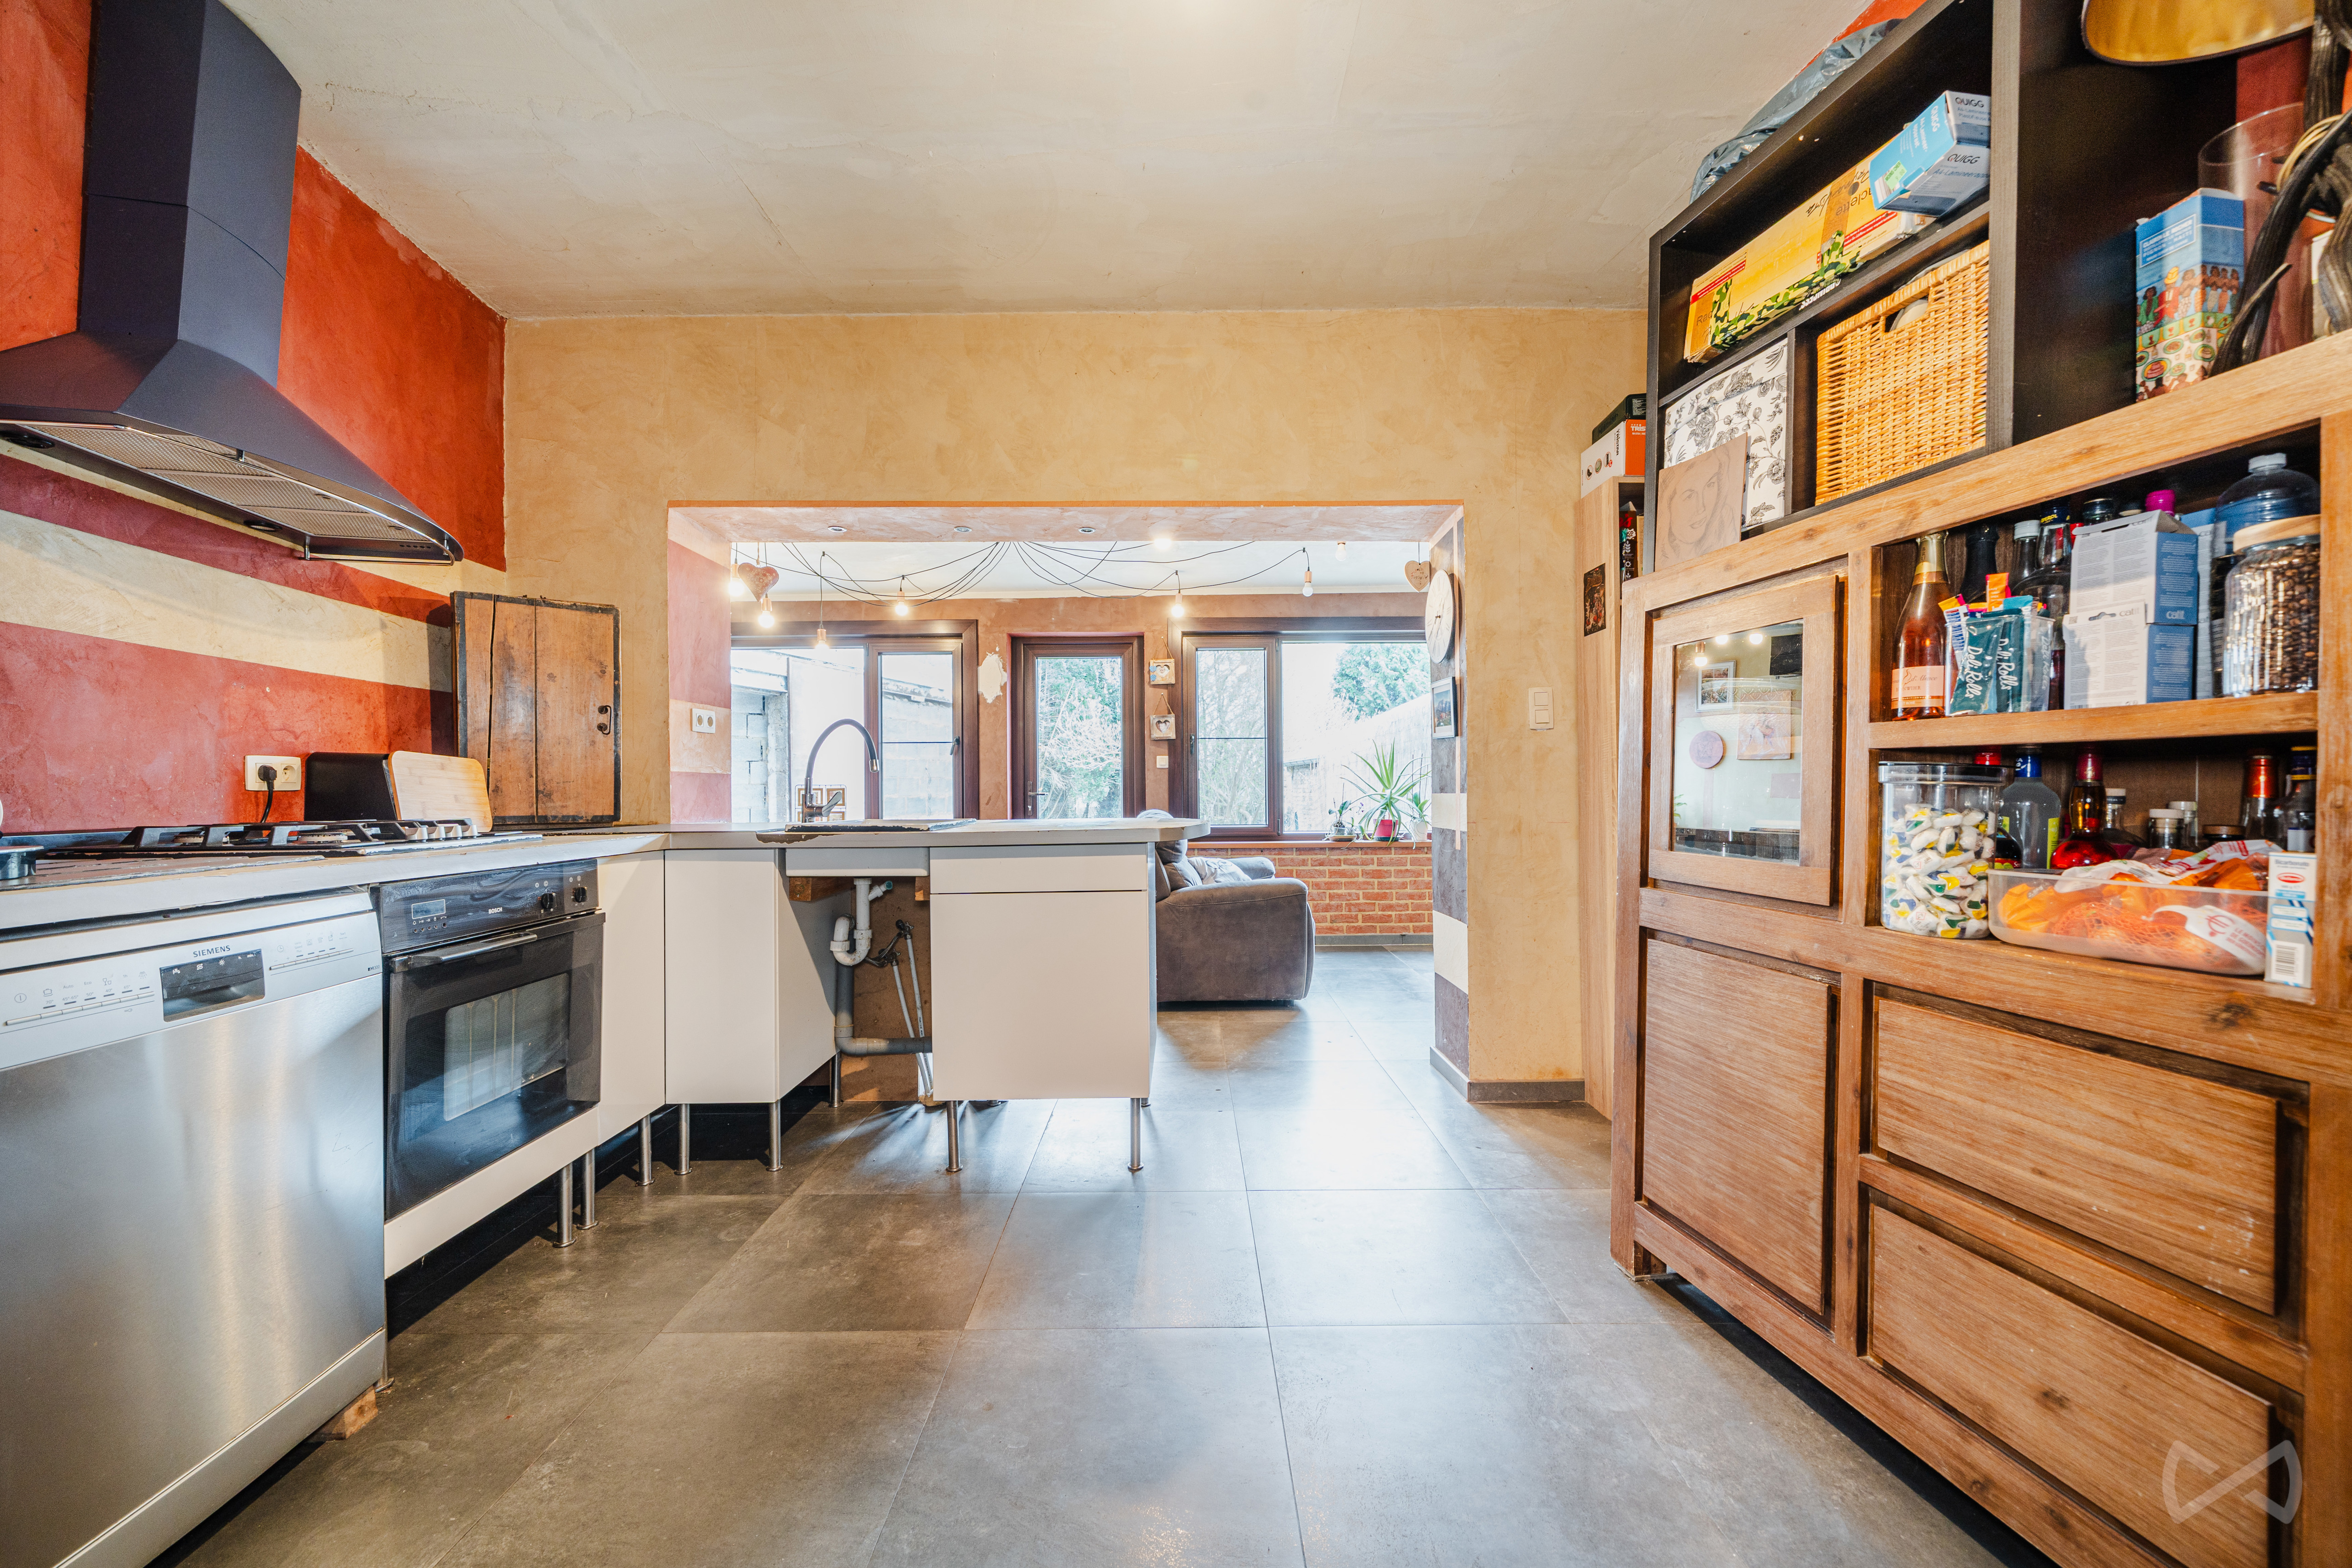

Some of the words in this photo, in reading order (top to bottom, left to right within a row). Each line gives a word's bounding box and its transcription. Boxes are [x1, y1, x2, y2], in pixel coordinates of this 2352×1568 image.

[1955, 97, 1984, 108] QUIGG
[1931, 106, 1940, 132] QUIGG
[1947, 153, 1980, 164] QUIGG
[1836, 187, 1871, 216] aclette
[1964, 645, 1983, 672] Deli
[1996, 638, 2012, 663] Deli
[1964, 671, 1983, 698] Rolls
[1998, 662, 2018, 690] Rolls
[193, 945, 231, 957] SIEMENS
